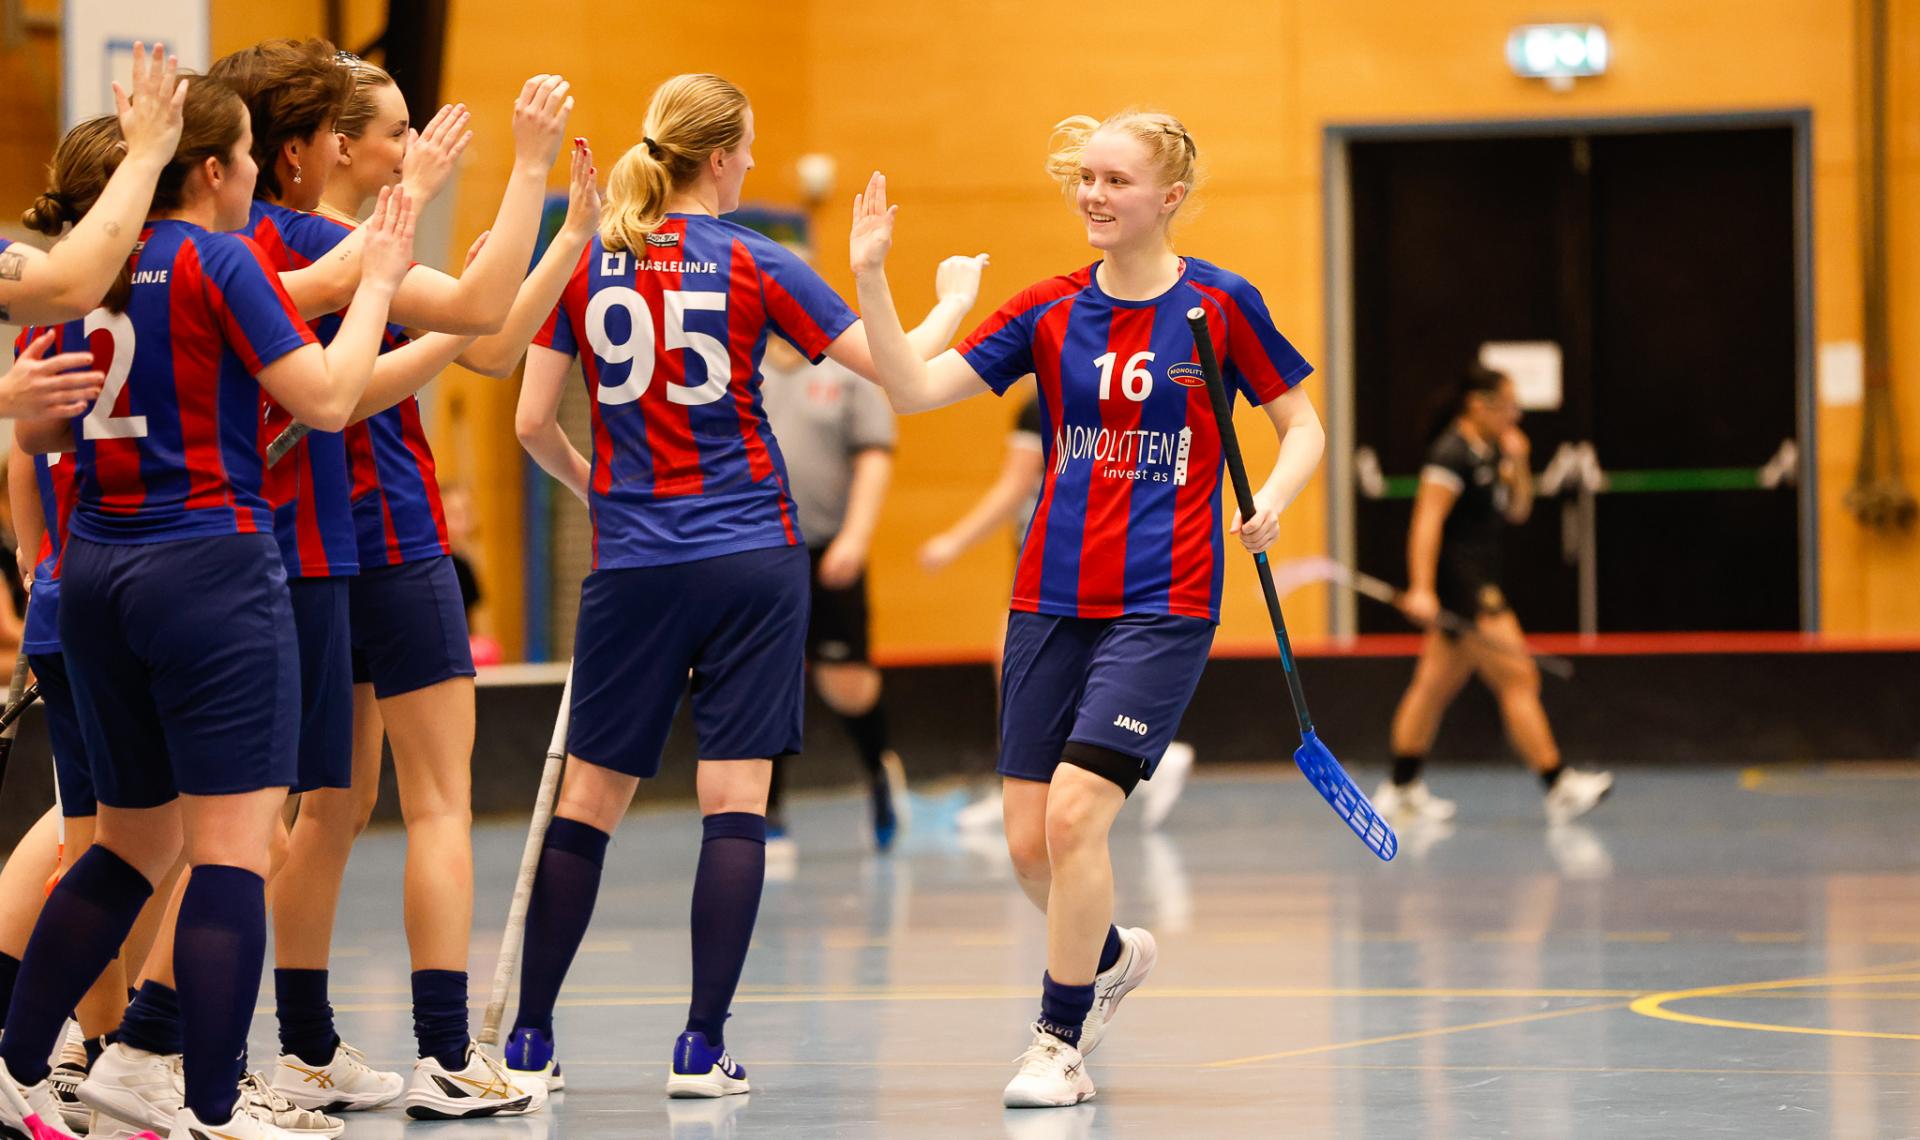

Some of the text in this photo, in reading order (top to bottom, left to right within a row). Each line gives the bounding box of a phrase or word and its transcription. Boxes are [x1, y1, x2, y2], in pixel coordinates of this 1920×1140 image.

[635, 259, 718, 274] HASLELINJE
[585, 286, 732, 405] 95
[83, 307, 148, 440] 2
[1093, 351, 1156, 402] 16
[1170, 367, 1206, 377] MONOLITT
[1054, 425, 1175, 474] MONOLITTEN
[1103, 467, 1169, 482] invest as
[1113, 714, 1148, 736] JAKO
